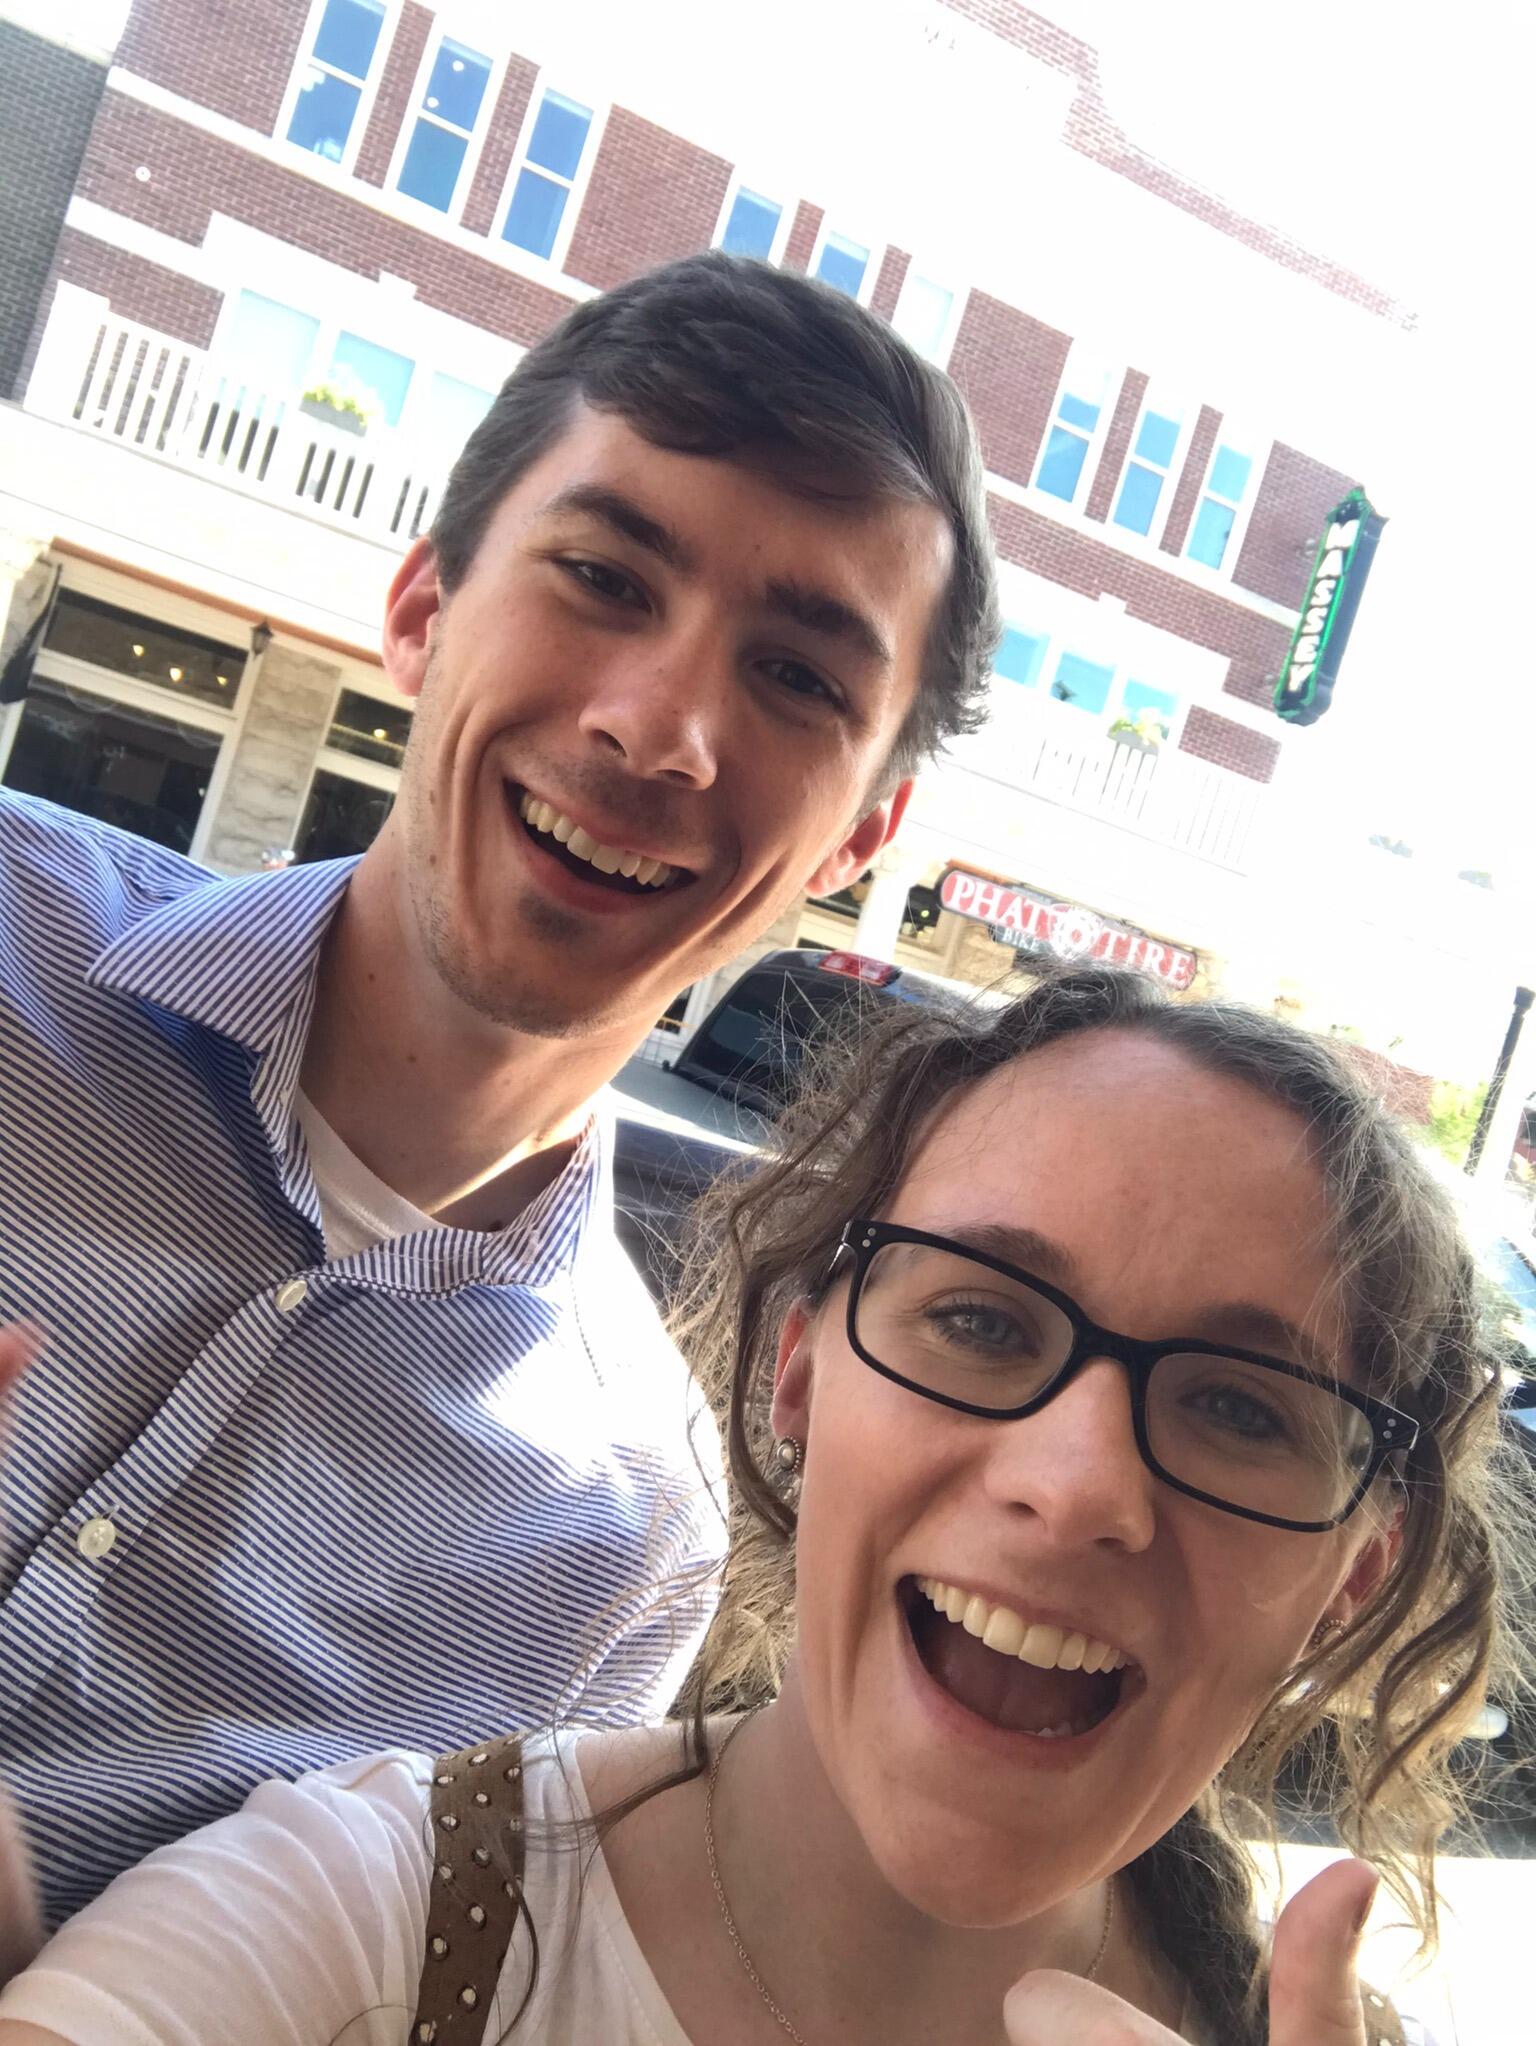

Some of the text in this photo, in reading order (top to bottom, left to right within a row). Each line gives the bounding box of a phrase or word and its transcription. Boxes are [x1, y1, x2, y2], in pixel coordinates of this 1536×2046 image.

[1288, 519, 1360, 692] MASSEY
[948, 874, 1192, 984] PHAT TIRE
